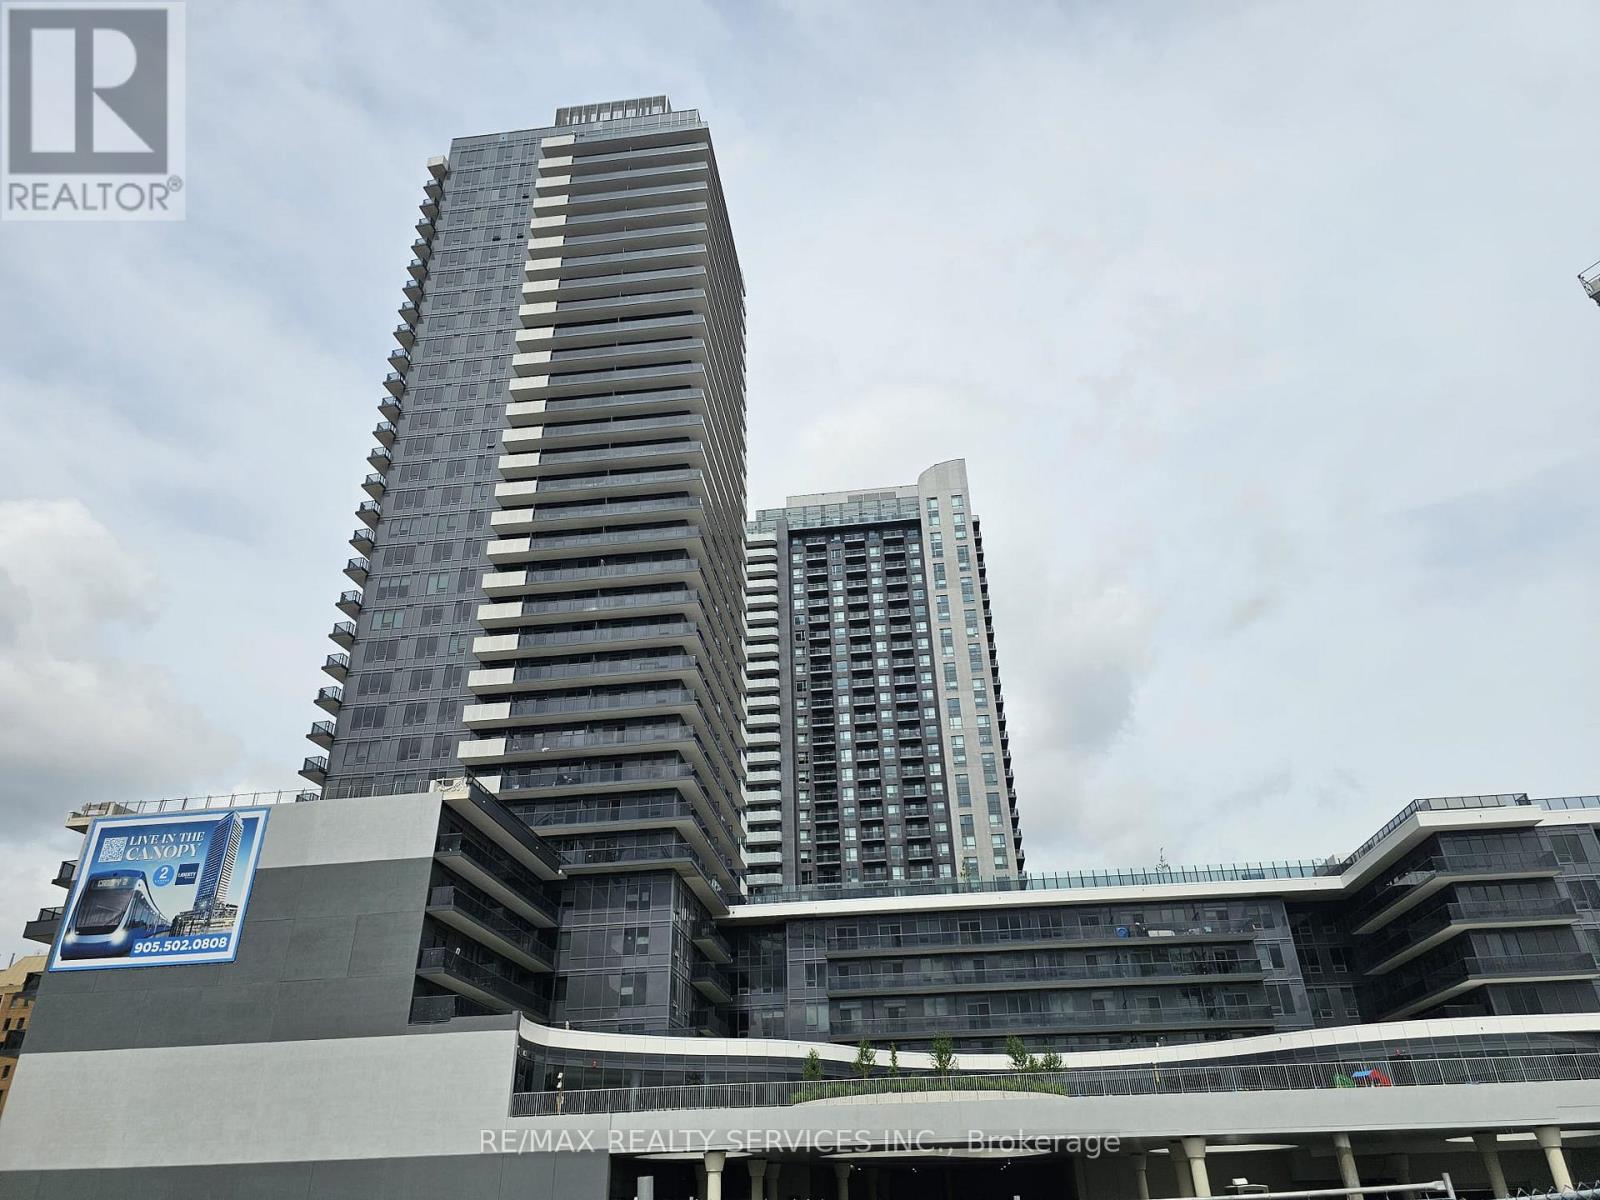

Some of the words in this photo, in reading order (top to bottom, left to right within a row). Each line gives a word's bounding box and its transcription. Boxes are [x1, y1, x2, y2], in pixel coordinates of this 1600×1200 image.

[129, 834, 159, 846] LIVE
[162, 833, 176, 844] IN
[180, 831, 205, 842] THE
[126, 843, 202, 861] CANOPY
[159, 867, 169, 879] 2
[134, 936, 228, 953] 905.502.0808
